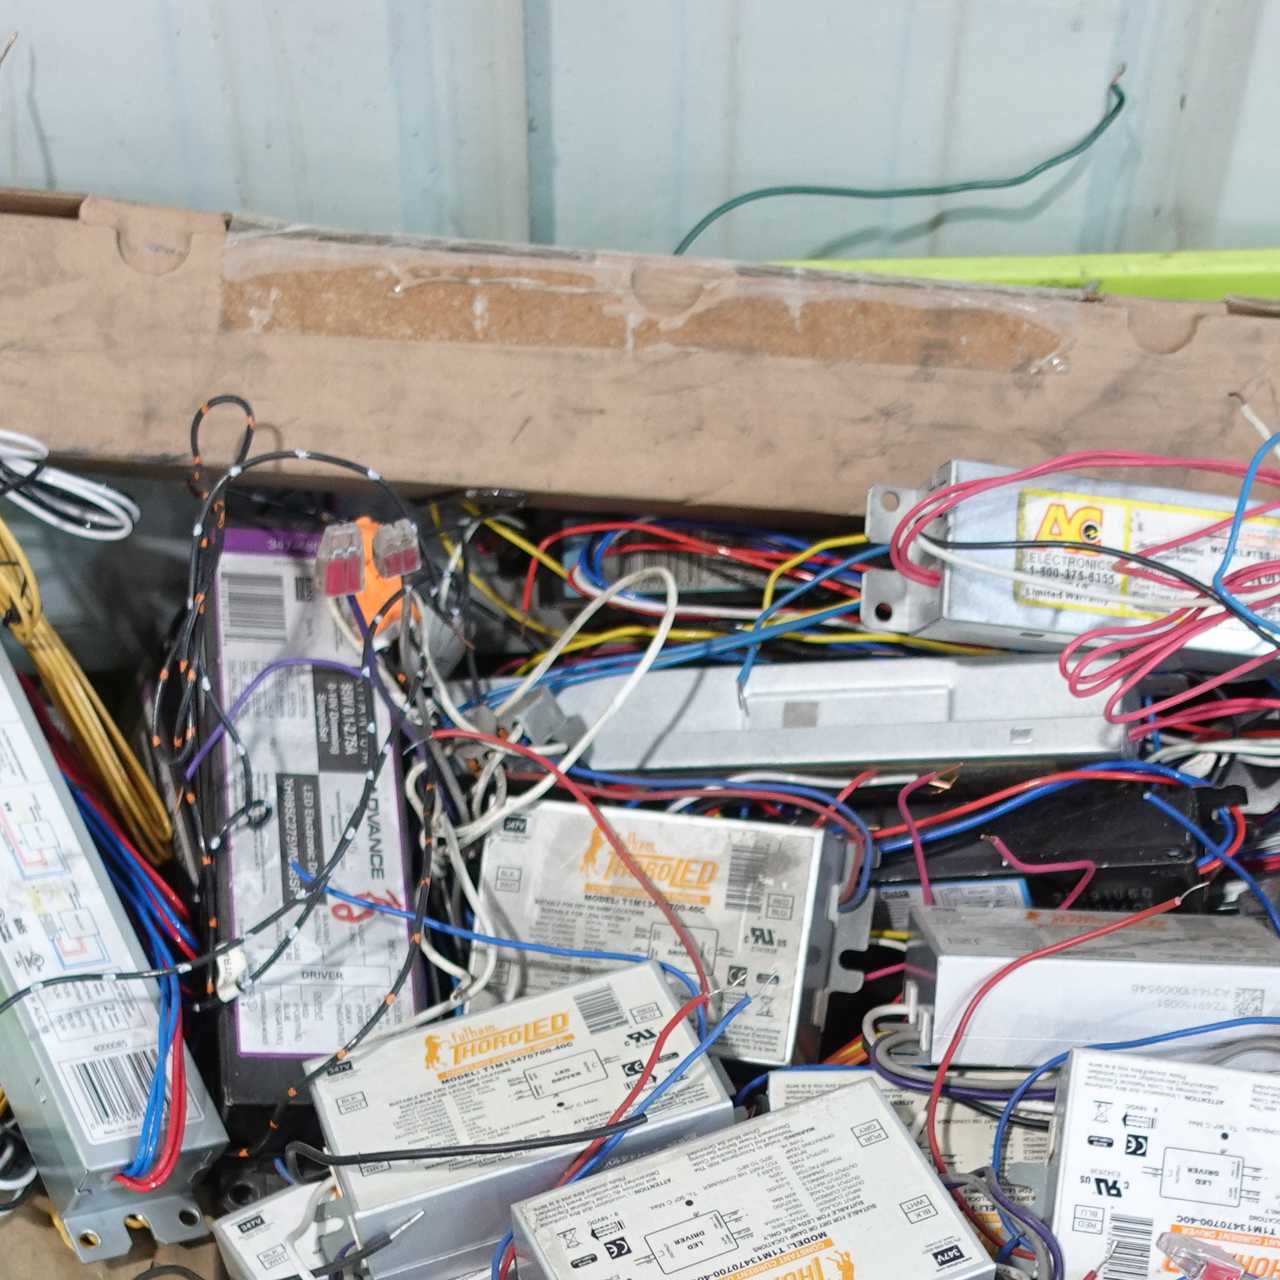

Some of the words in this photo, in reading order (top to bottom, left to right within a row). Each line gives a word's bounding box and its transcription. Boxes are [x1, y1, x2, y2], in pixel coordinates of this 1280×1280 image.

[300, 970, 344, 980] DRIVER
[856, 1122, 877, 1134] GRY
[862, 1131, 882, 1143] PUR
[903, 1198, 925, 1210] WHT
[913, 1208, 931, 1218] BLK
[673, 1229, 705, 1245] DRIVER
[785, 1230, 827, 1250] MODEL:
[686, 1240, 703, 1250] LED
[934, 1247, 960, 1262] 347V
